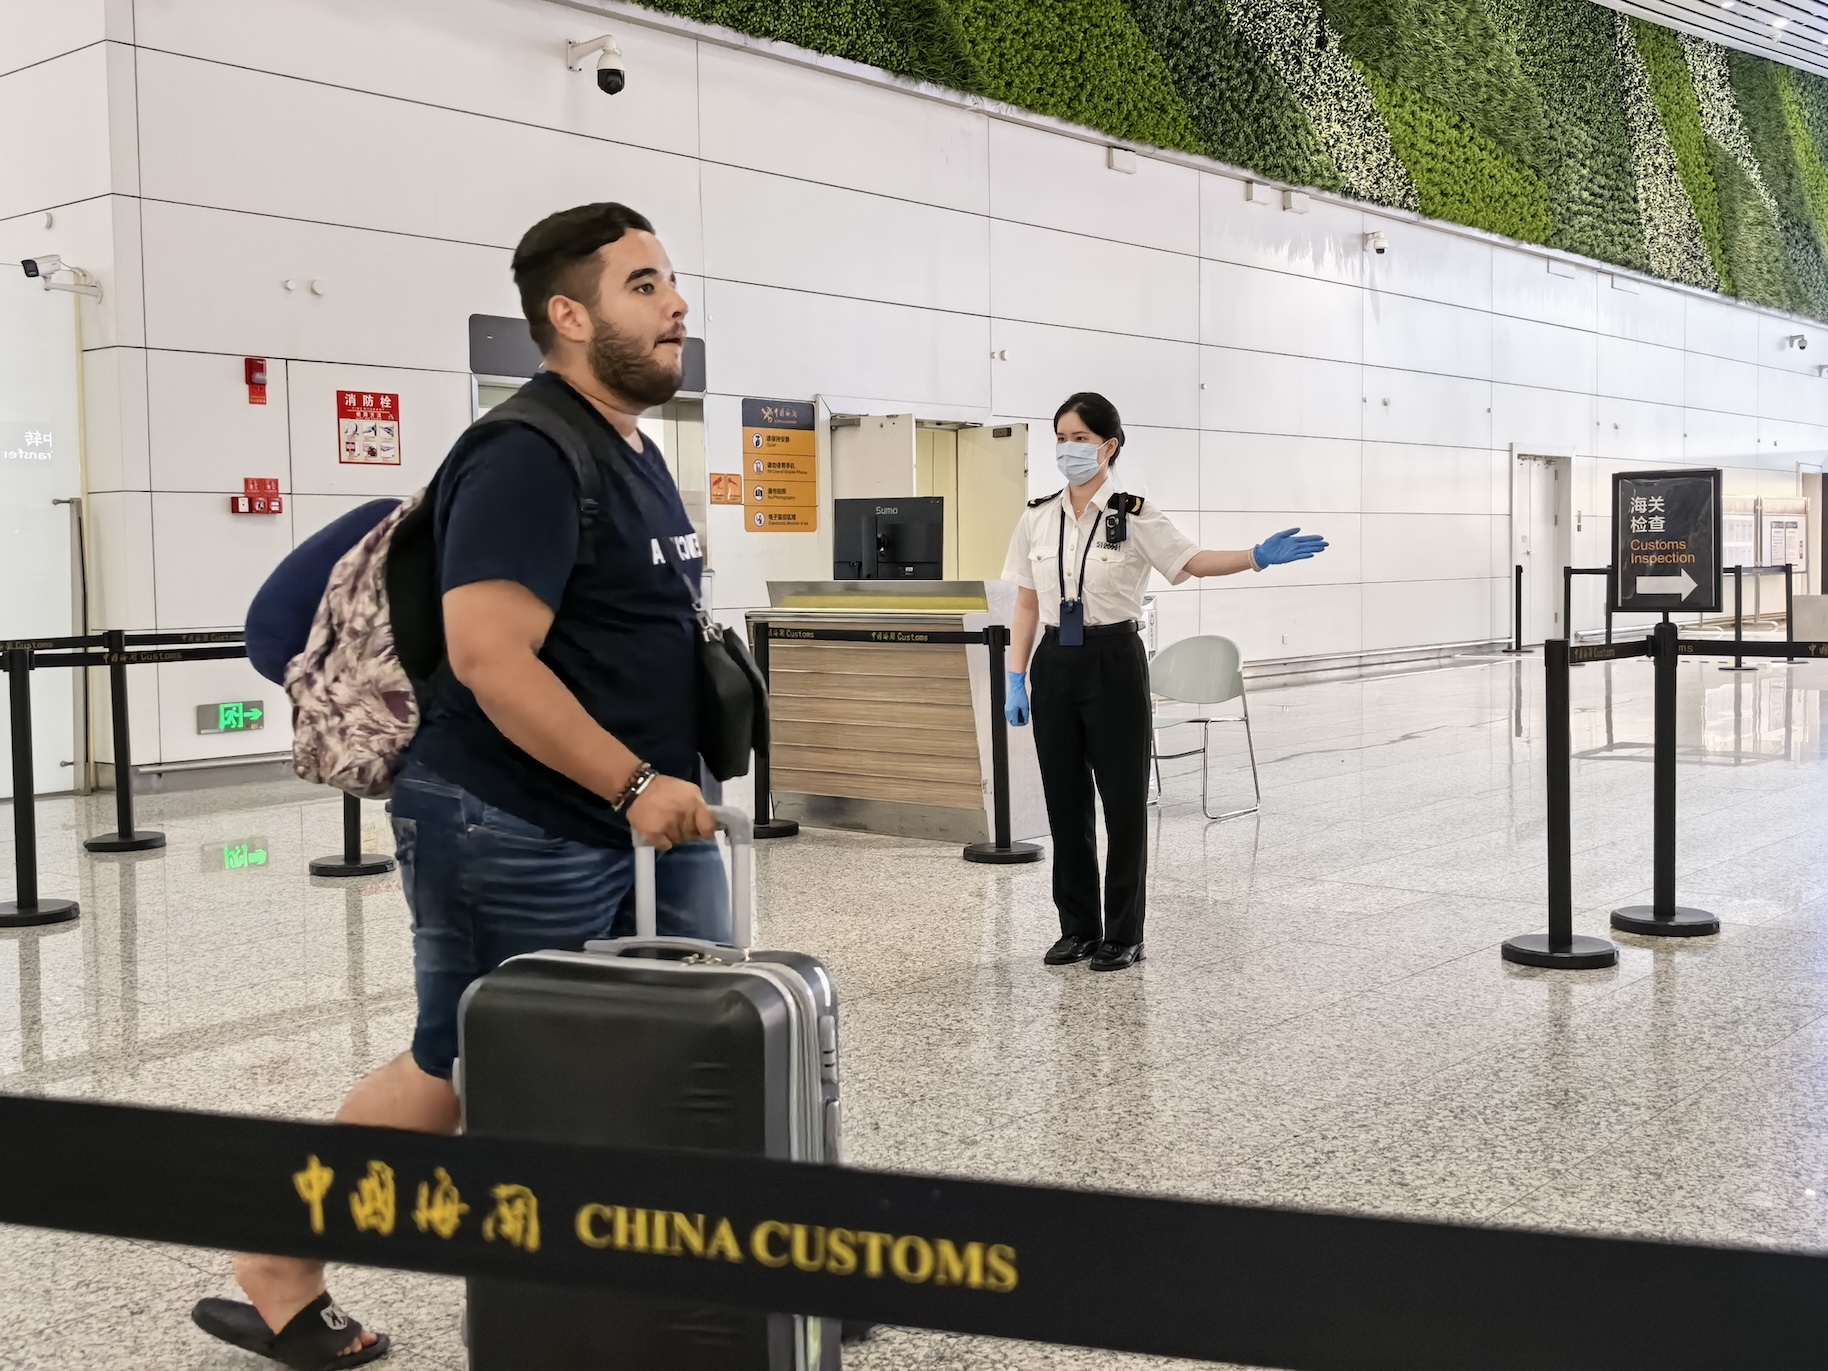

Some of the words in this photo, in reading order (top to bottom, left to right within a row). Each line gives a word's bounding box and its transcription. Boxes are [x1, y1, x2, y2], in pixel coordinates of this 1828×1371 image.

[344, 393, 392, 409] 消防栓
[1630, 495, 1666, 514] 海关
[1630, 515, 1666, 533] 检查
[1630, 539, 1687, 551] Customs
[1630, 552, 1696, 567] Inspection
[786, 630, 815, 639] Customs
[896, 632, 929, 642] Customs
[140, 651, 182, 661] Customs
[576, 1203, 743, 1262] CHINA
[751, 1220, 1019, 1292] CUSTOMS
